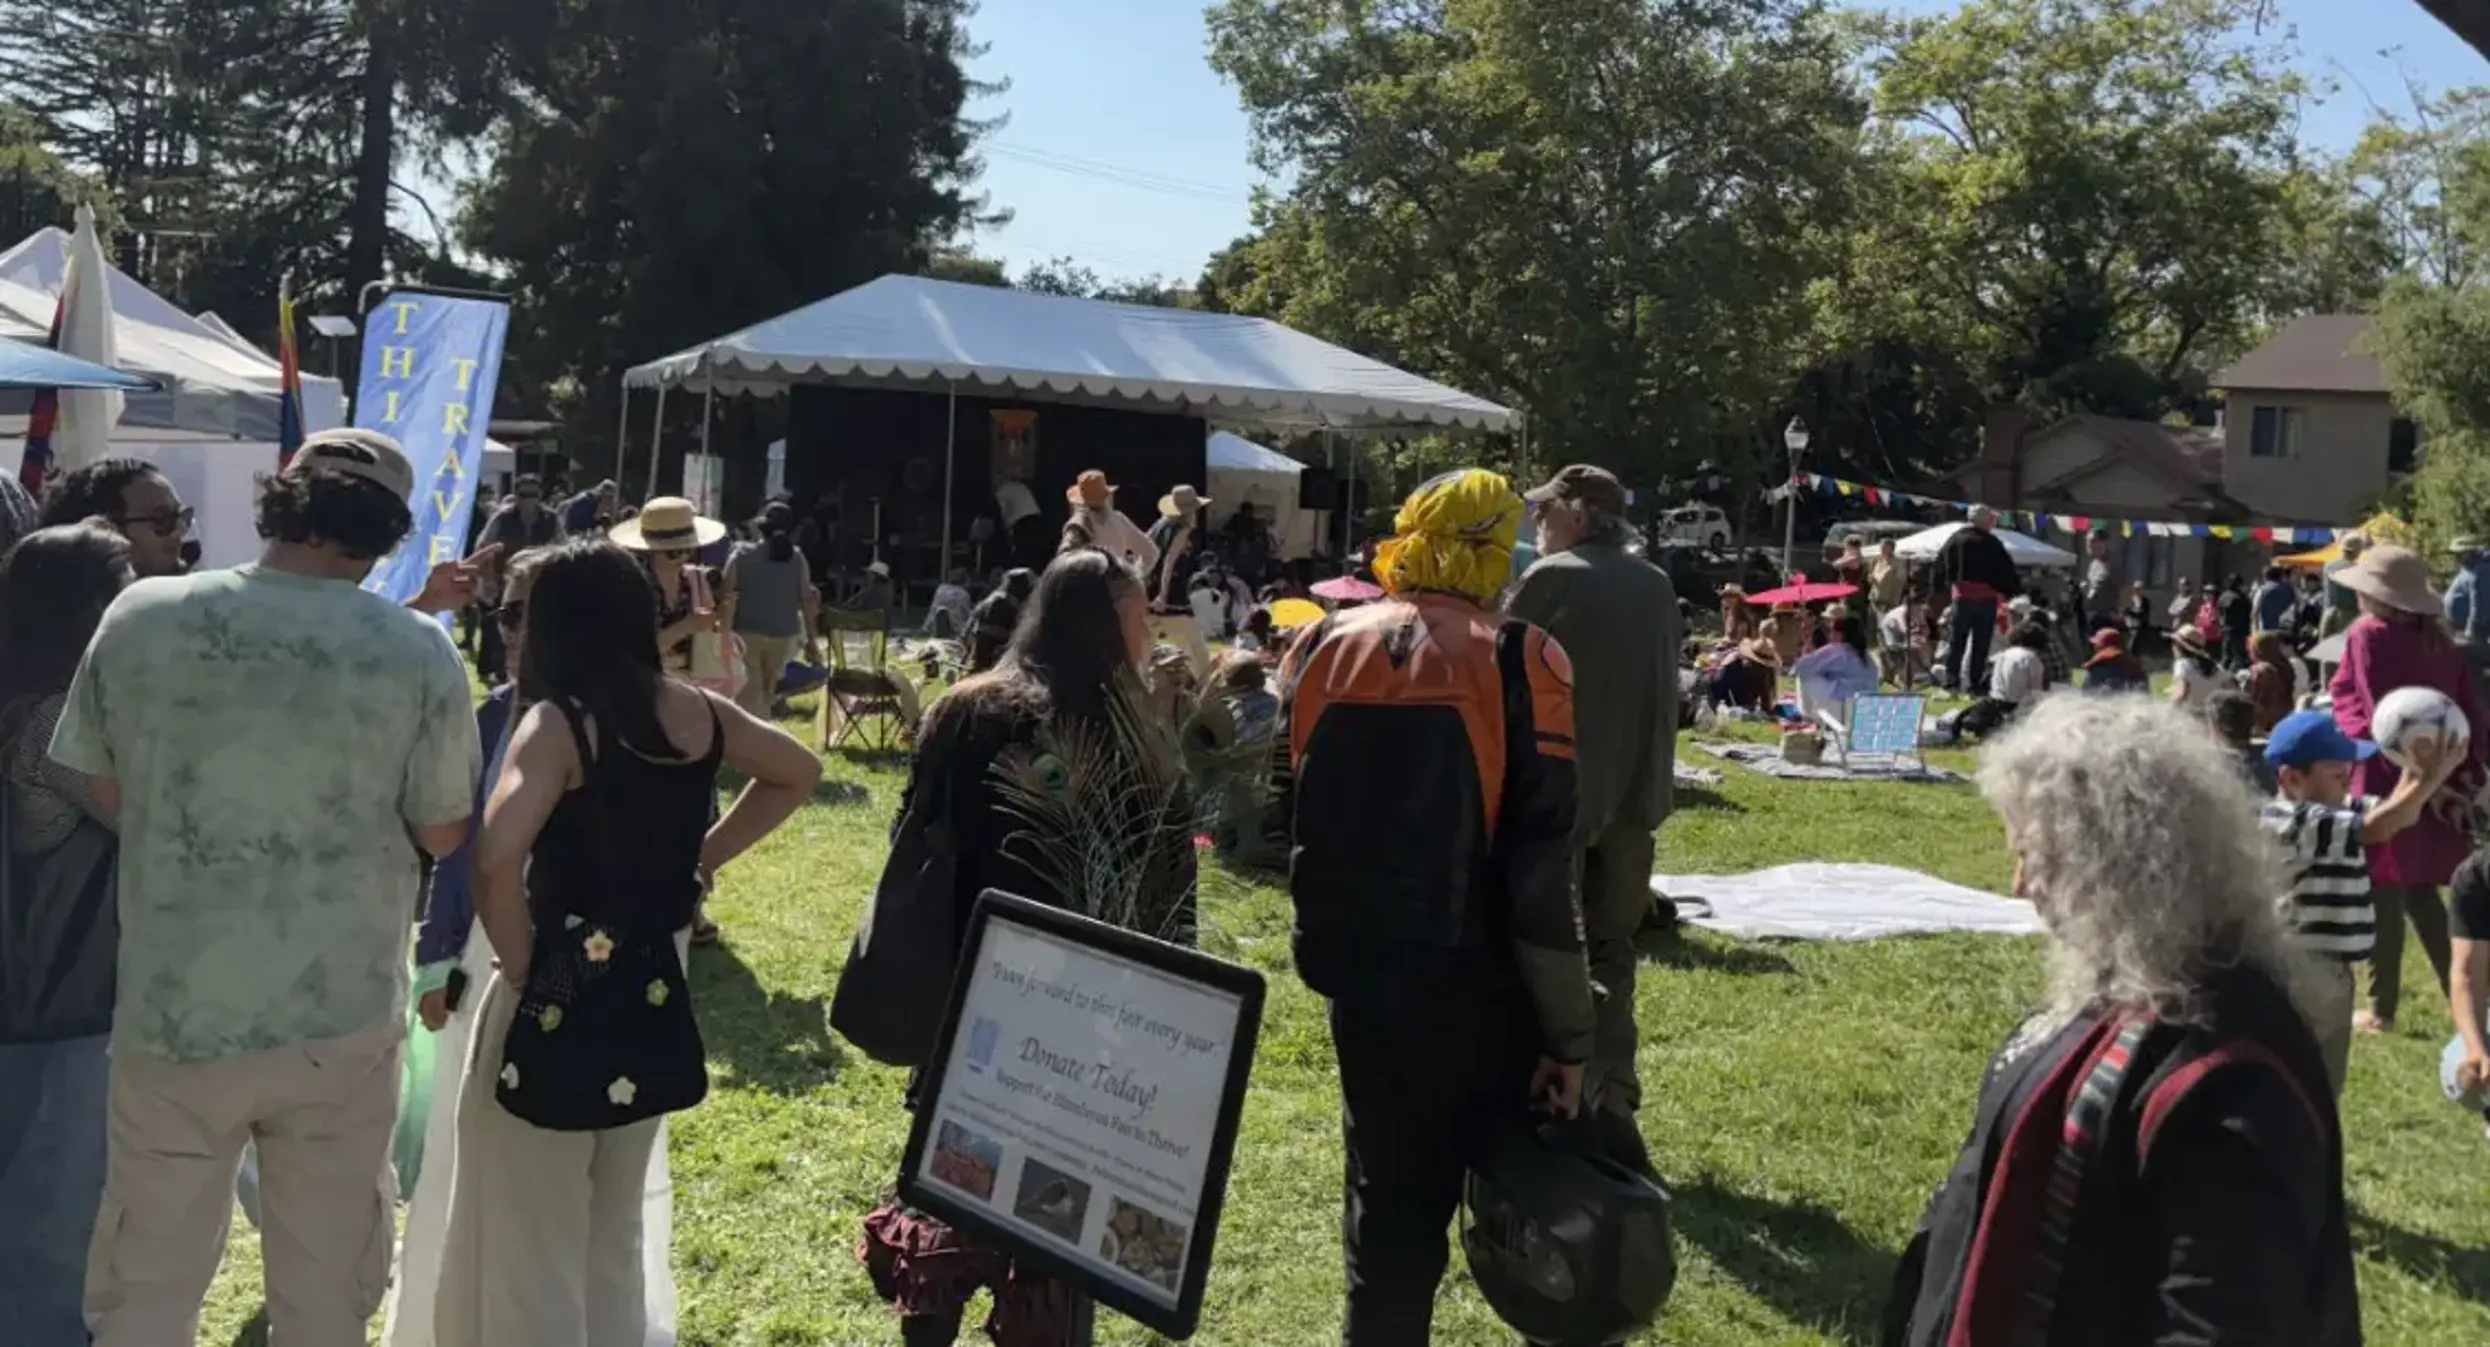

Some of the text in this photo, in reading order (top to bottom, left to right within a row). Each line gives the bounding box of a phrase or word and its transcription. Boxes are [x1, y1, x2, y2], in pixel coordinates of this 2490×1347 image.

[429, 358, 478, 567] TRAVE
[1018, 1035, 1159, 1121] Donate Today!
[1144, 1020, 1182, 1052] every
